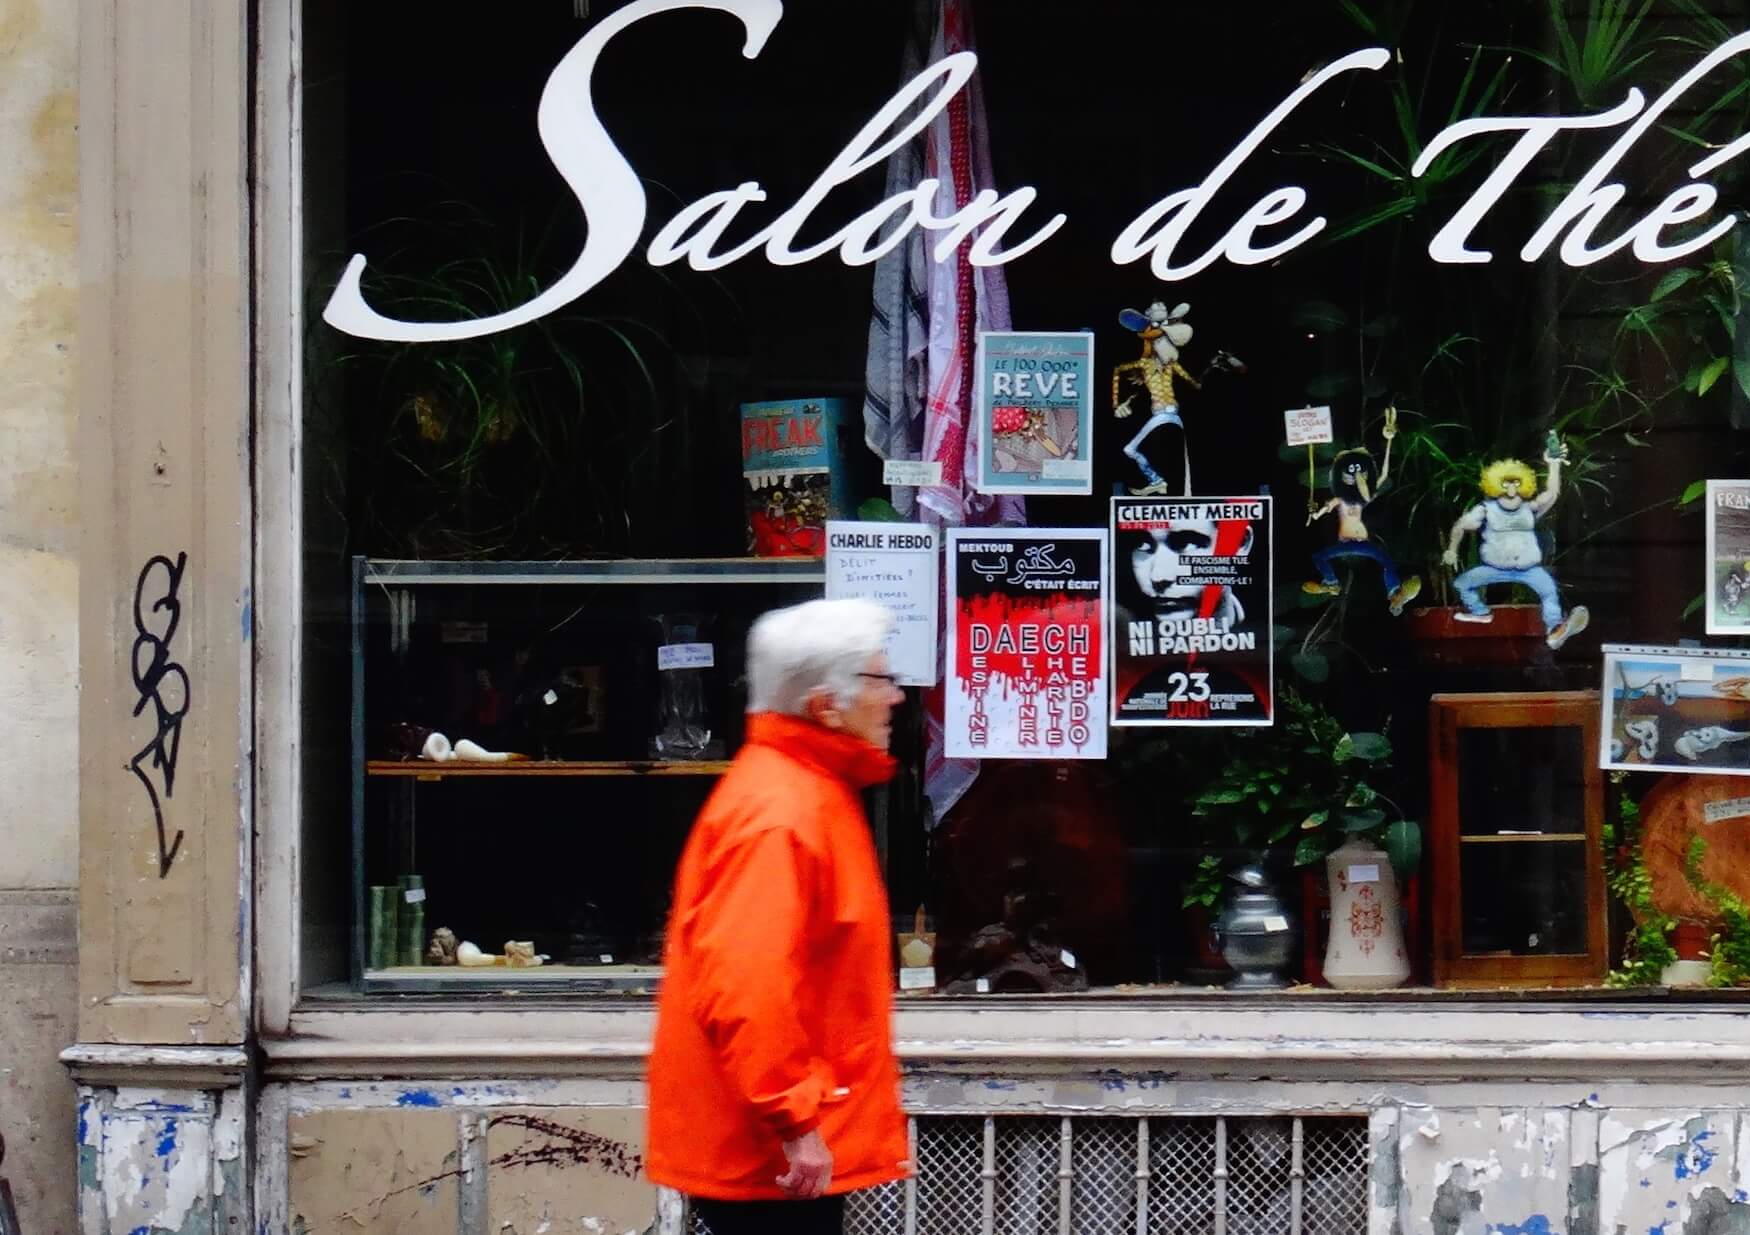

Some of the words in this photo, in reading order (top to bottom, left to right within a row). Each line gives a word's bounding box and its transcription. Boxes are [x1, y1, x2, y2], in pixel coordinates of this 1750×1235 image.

[323, 0, 1067, 342] Salon
[1111, 47, 1391, 281] de
[1122, 506, 1200, 520] CLEMENT
[1206, 504, 1259, 519] MERIC
[830, 534, 883, 548] CHARLIE
[888, 534, 933, 549] HEBDO
[959, 543, 1014, 553] MEKTOUB
[972, 544, 1076, 584] مكتوب
[971, 624, 1090, 654] DAECH
[1128, 621, 1153, 638] NI
[1159, 617, 1231, 637] OUBLI
[1129, 638, 1155, 656] NI
[1160, 632, 1256, 655] PARDON
[1168, 672, 1211, 702] 23
